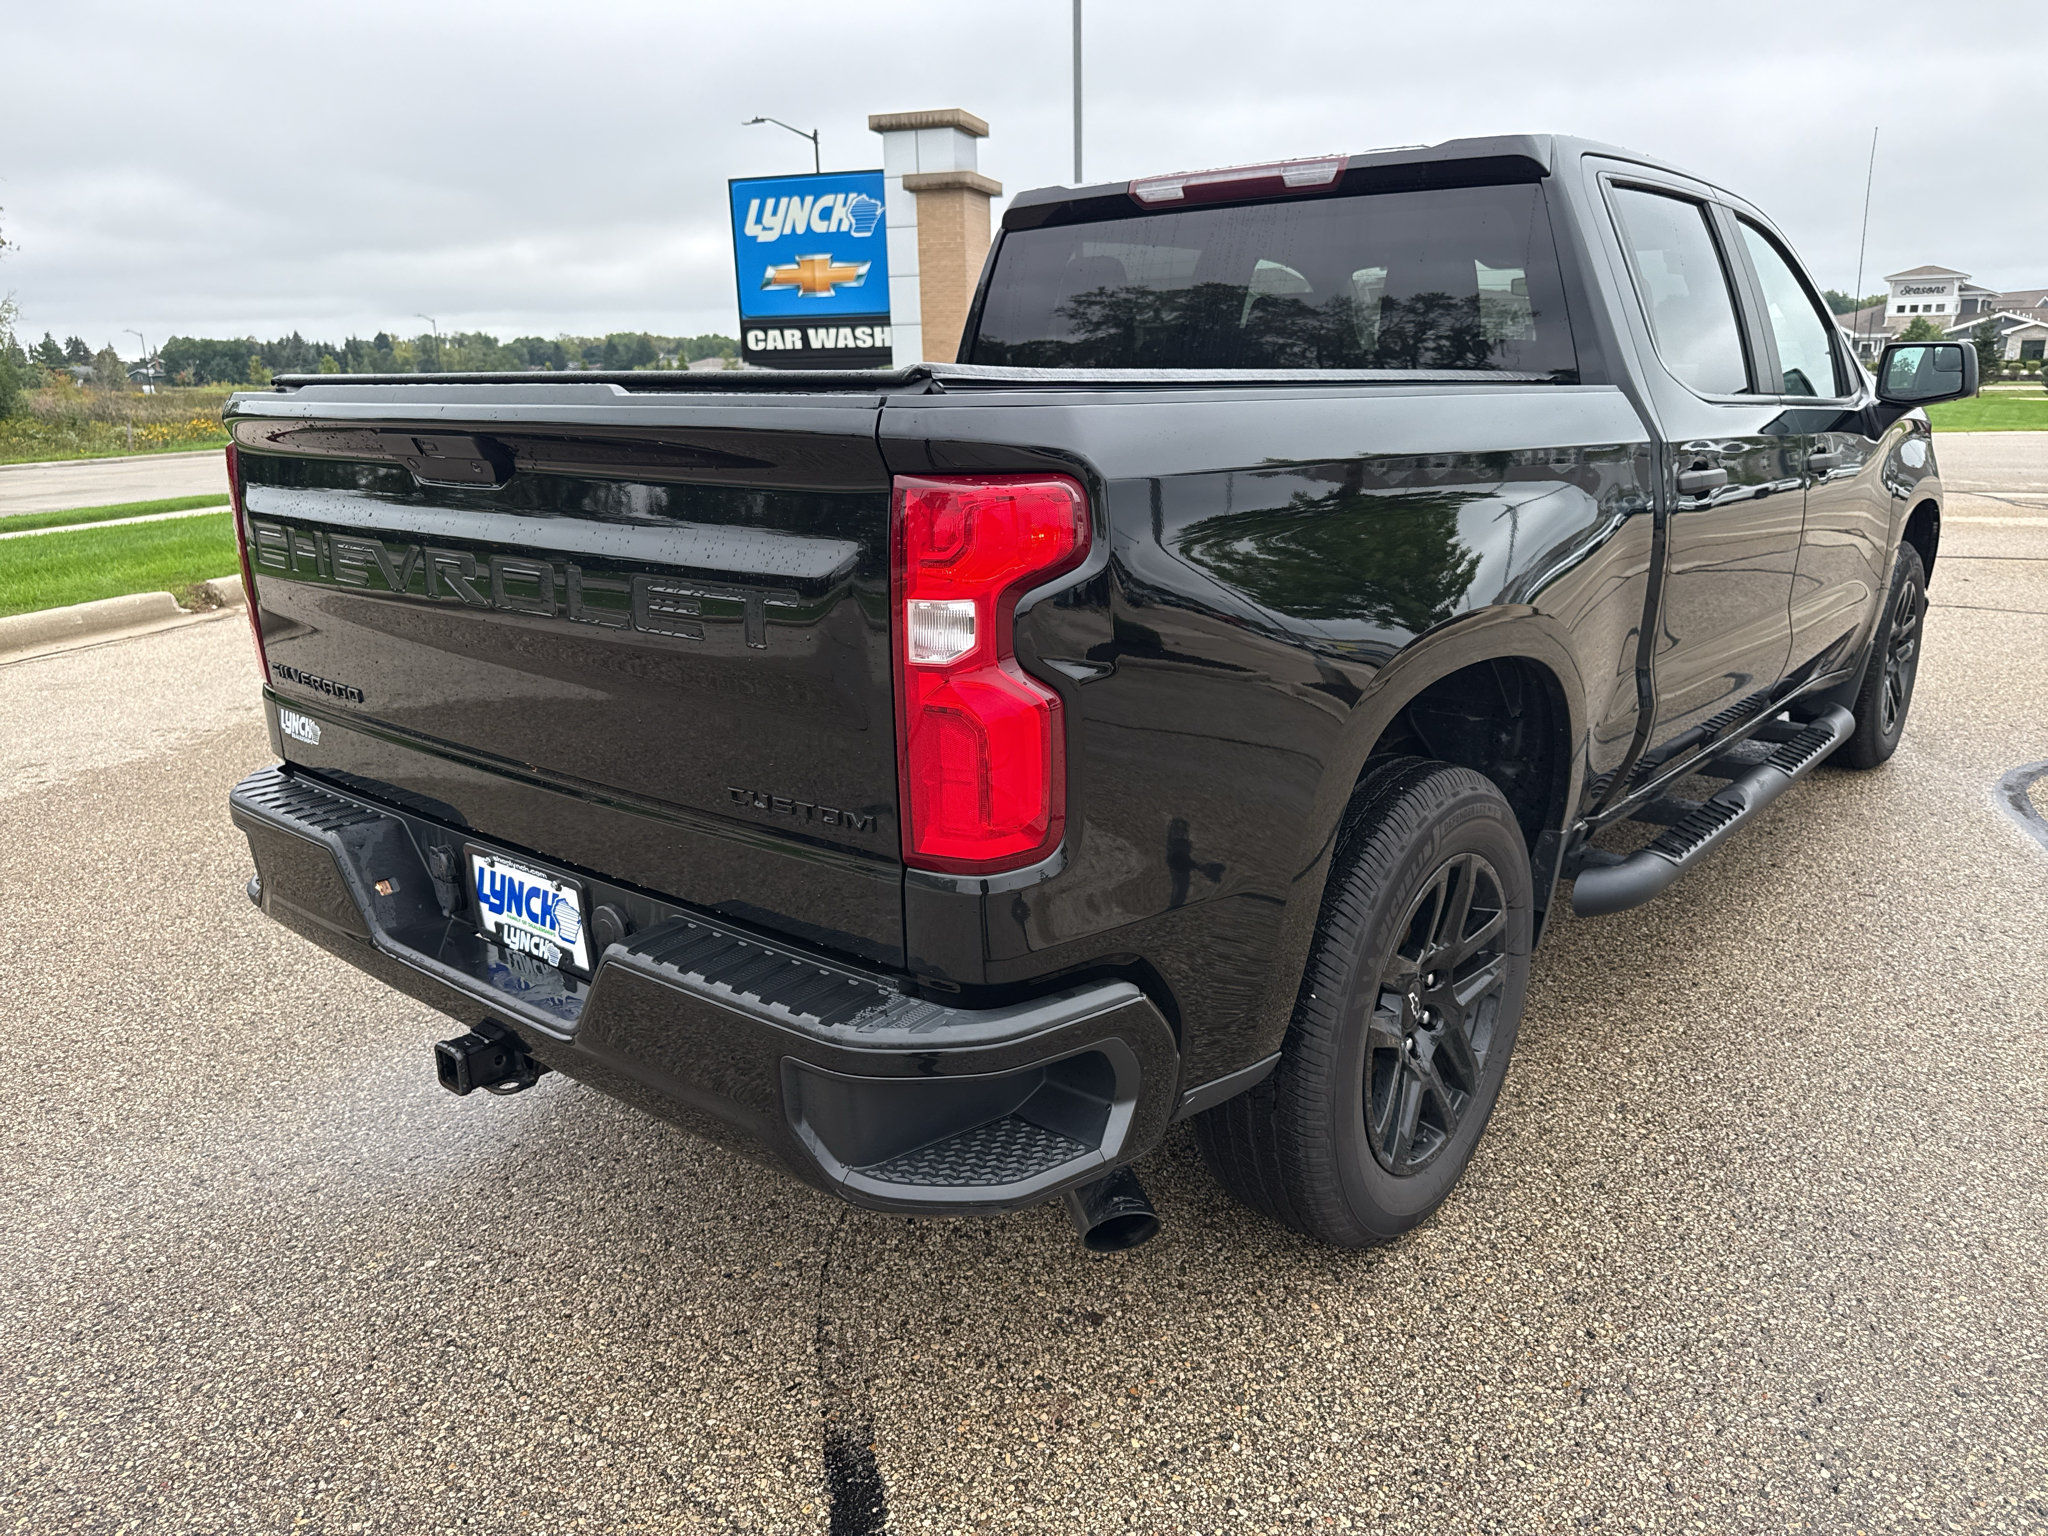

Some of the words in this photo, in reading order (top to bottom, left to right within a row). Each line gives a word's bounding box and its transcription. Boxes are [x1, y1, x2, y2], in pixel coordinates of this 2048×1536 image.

[744, 193, 857, 242] LYNCH
[1900, 285, 1946, 296] Seasons
[747, 330, 802, 351] CAR
[807, 326, 892, 349] WASH
[254, 520, 799, 650] CHEVROLET
[272, 662, 365, 704] SILVERADO
[280, 708, 314, 739] LYNCH
[727, 786, 878, 833] CUSTOM
[477, 866, 560, 931] LYNCH
[503, 924, 552, 960] LYNCH
